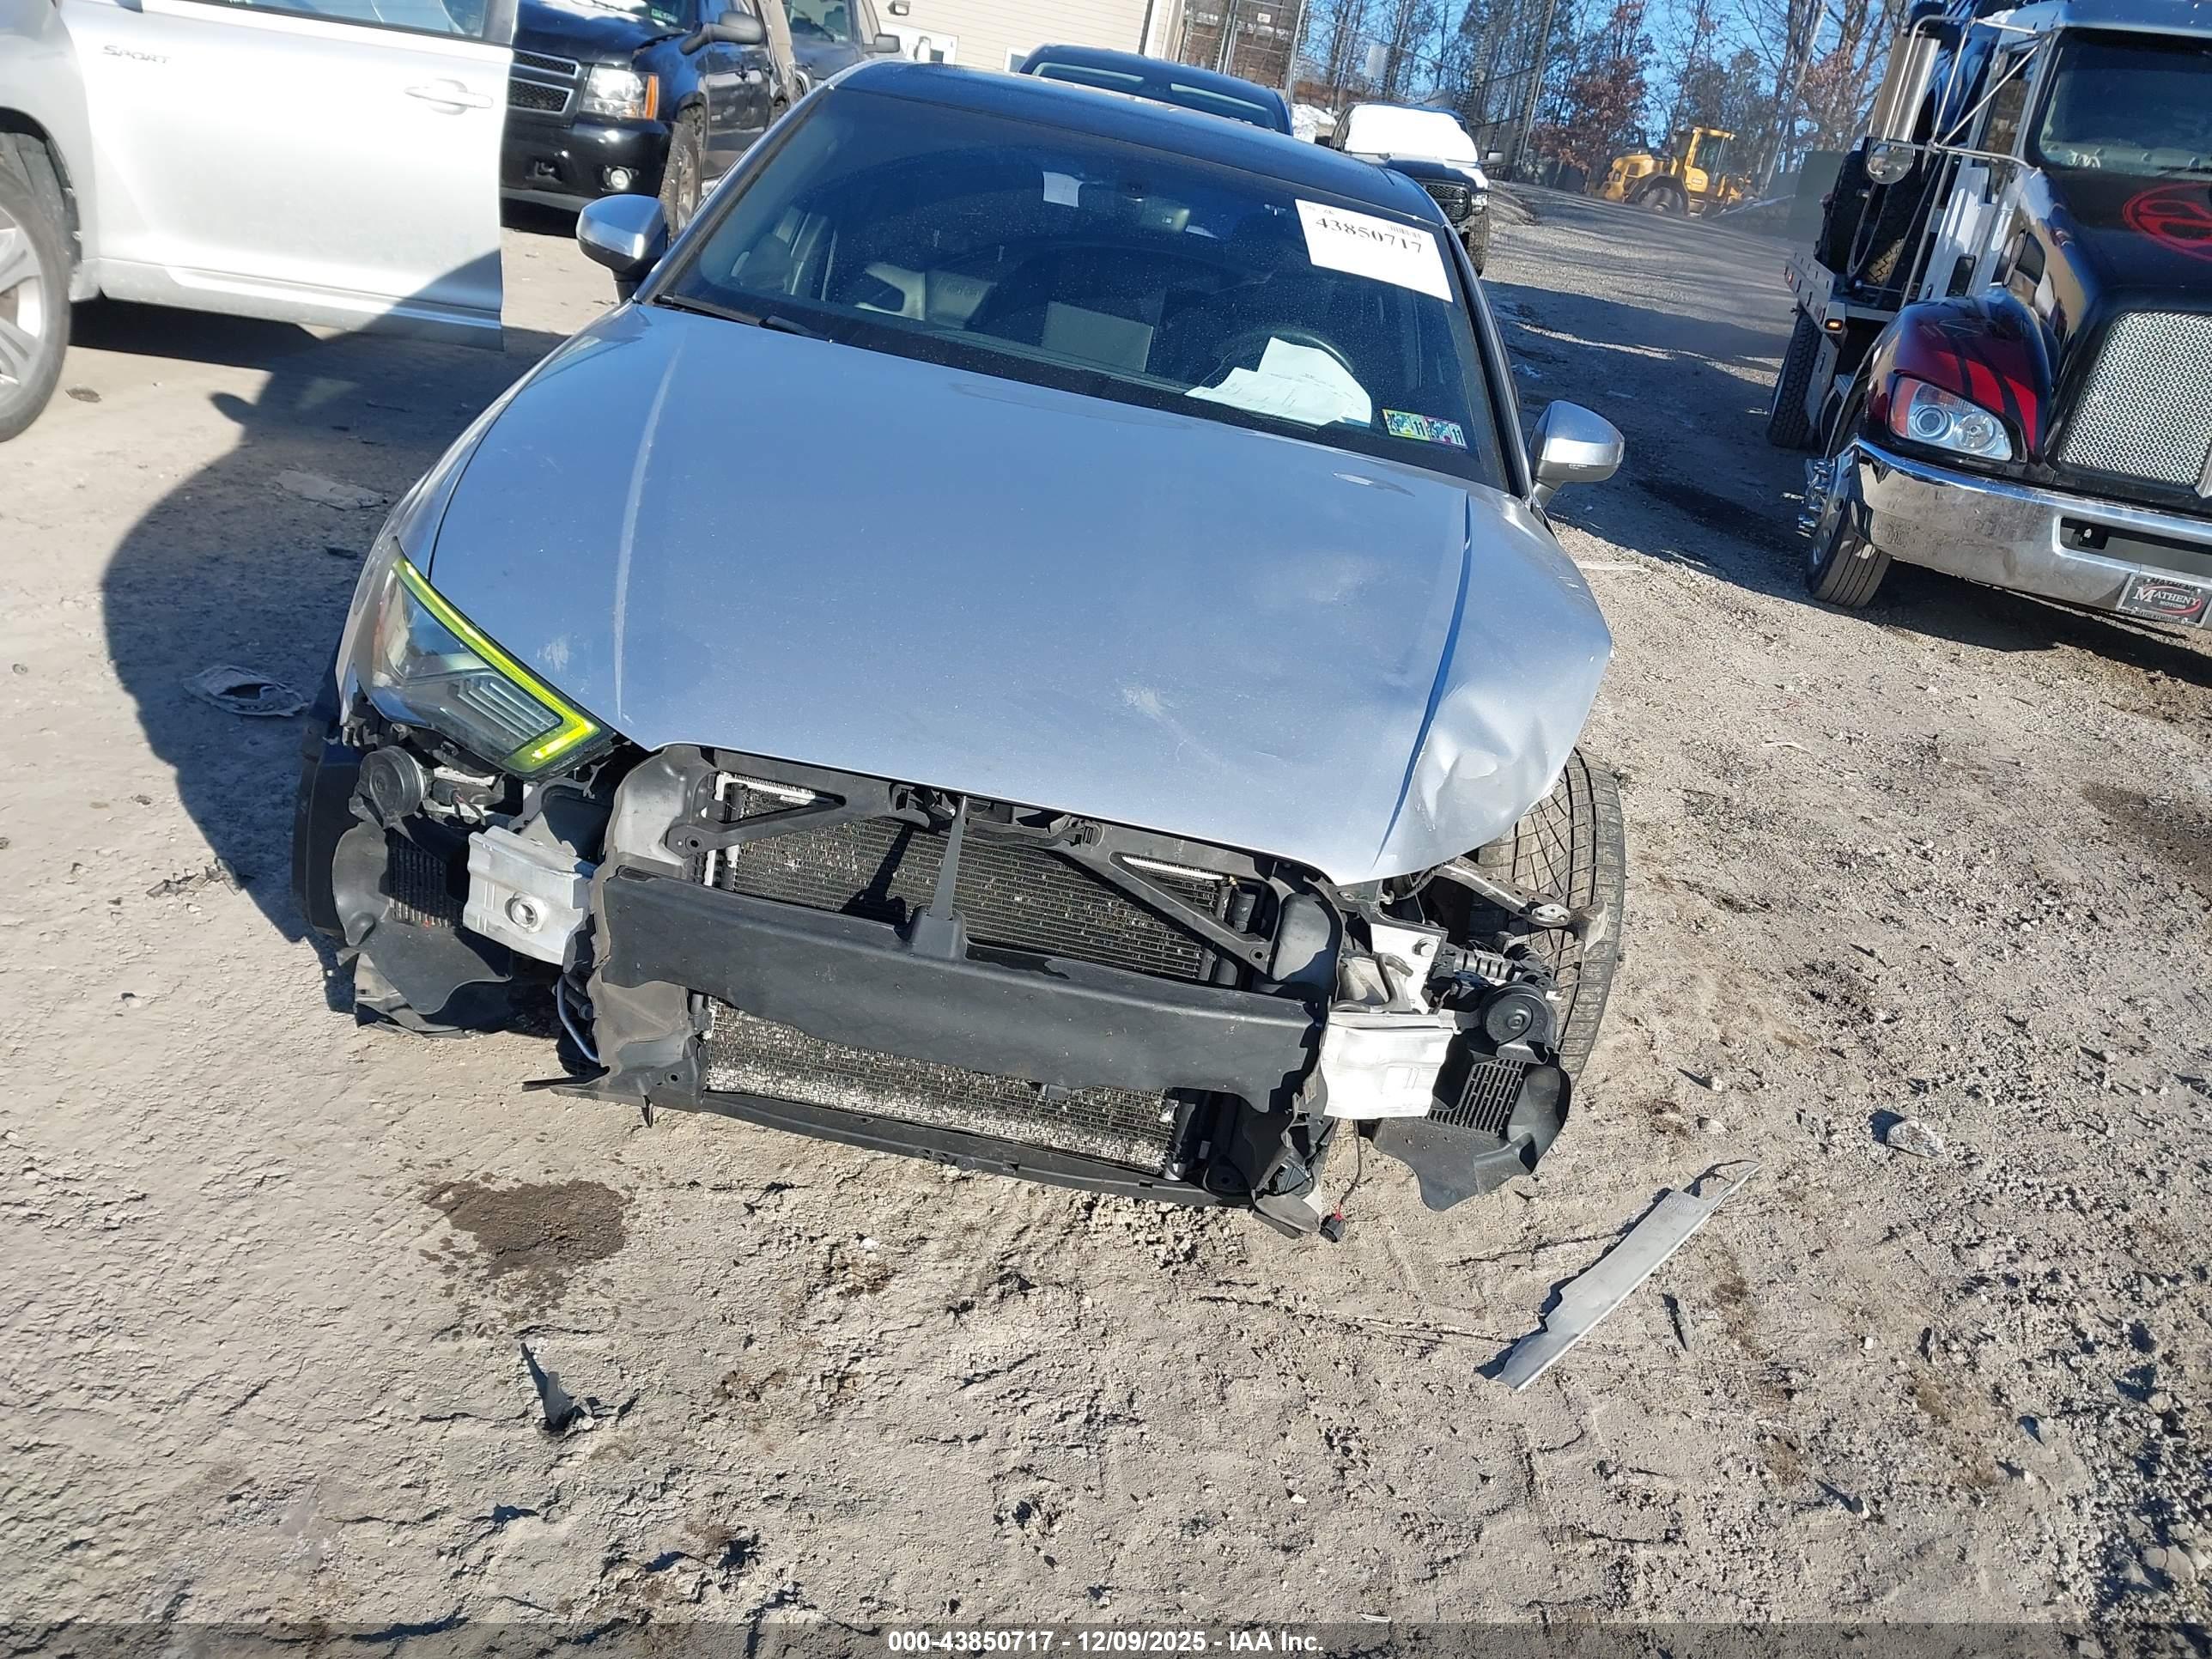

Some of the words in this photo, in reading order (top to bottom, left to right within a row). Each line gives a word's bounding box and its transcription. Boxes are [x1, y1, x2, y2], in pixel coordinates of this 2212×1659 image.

[1316, 217, 1422, 253] 43850717
[1413, 420, 1426, 437] 11
[1452, 428, 1464, 445] 11
